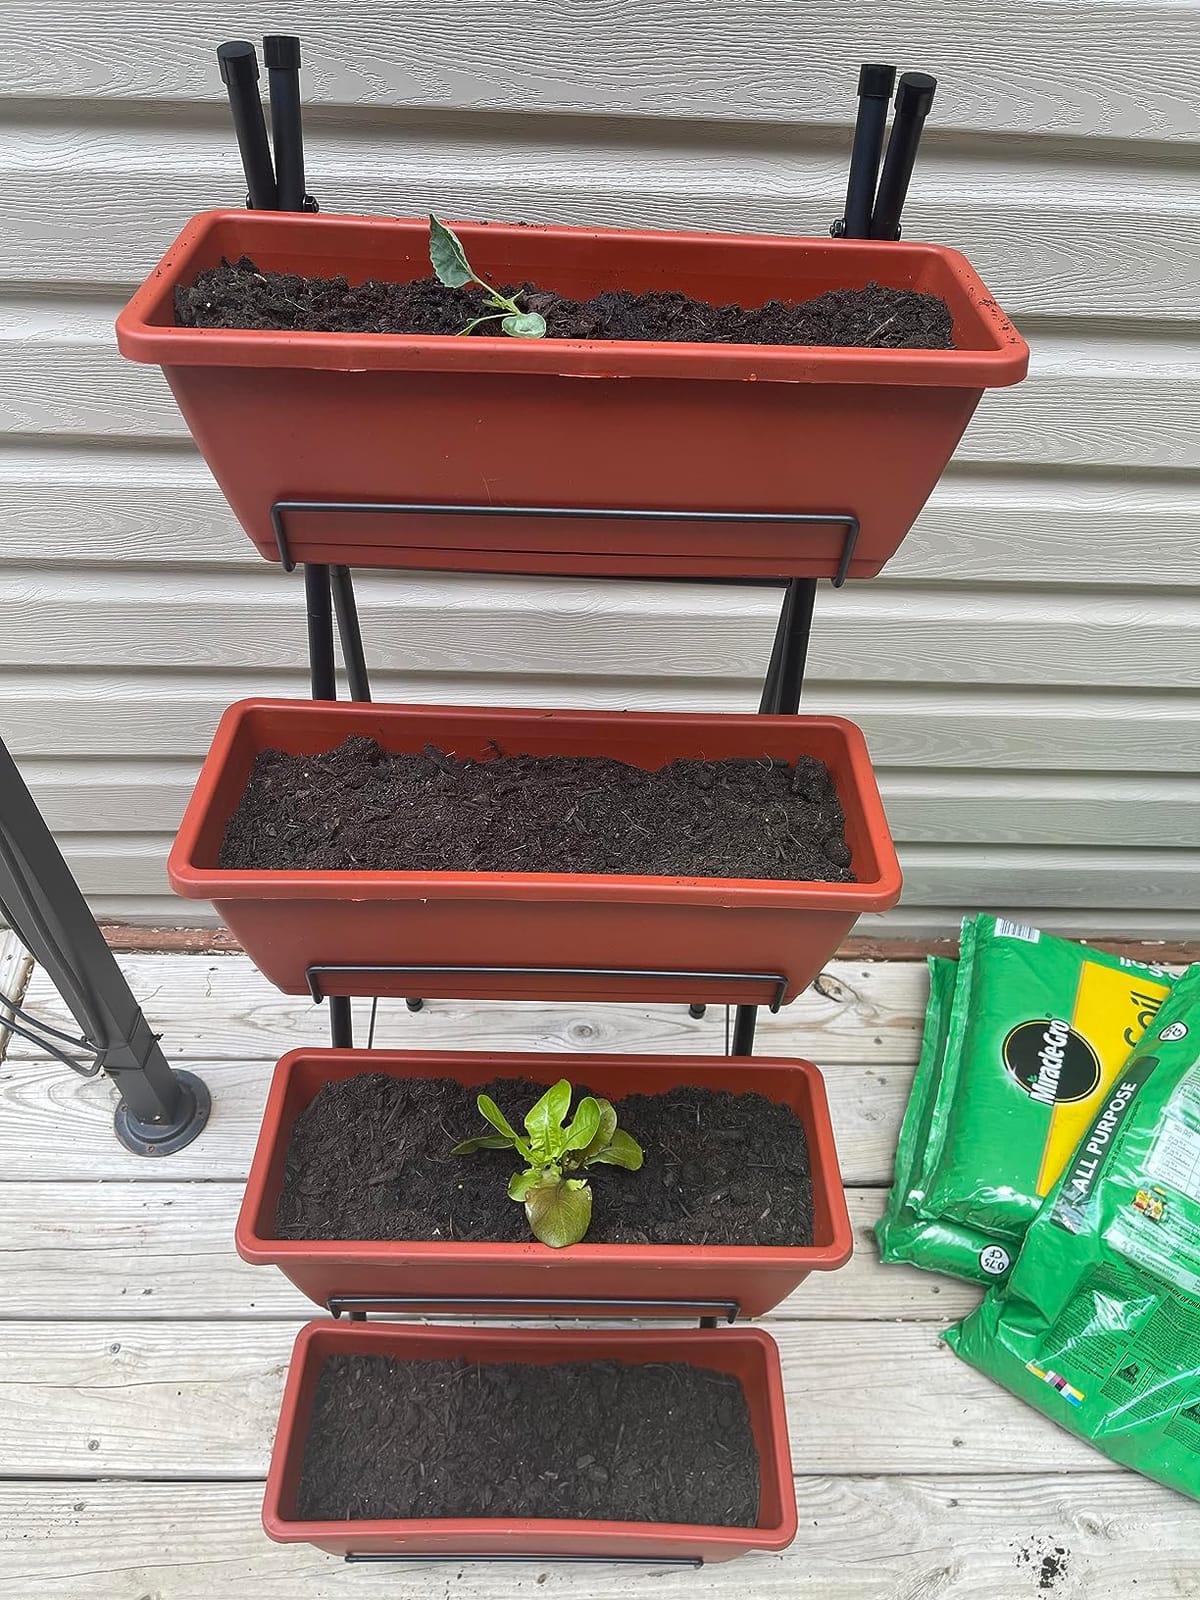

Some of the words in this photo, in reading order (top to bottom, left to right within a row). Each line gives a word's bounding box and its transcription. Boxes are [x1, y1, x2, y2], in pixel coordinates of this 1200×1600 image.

[1030, 1019, 1070, 1105] Miracle-Gro
[1071, 1160, 1098, 1194] ALL
[1087, 1081, 1137, 1155] PURPOSE
[984, 1258, 1005, 1271] 0.75
[989, 1249, 1003, 1259] CF
